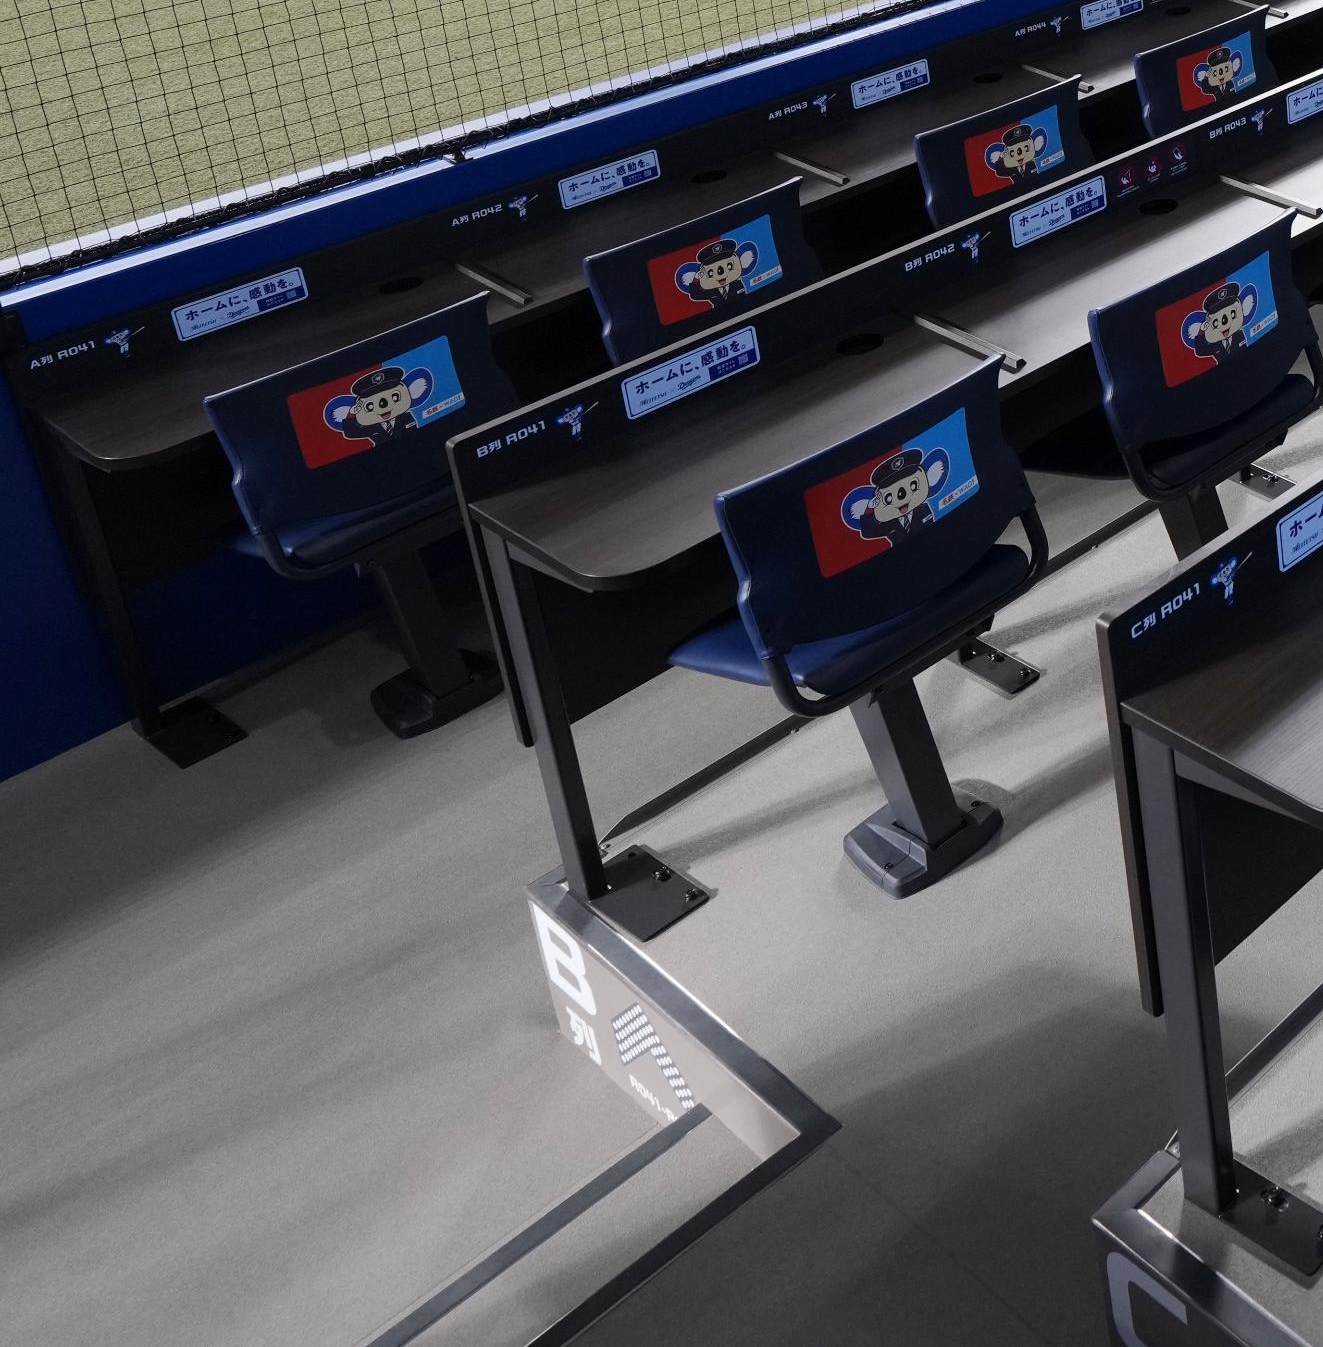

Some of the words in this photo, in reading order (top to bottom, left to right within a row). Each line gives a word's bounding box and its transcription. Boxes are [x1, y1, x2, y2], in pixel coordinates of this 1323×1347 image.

[1027, 21, 1046, 33] R044
[858, 67, 923, 94] ホームに、感動を。
[768, 111, 782, 120] A列
[784, 101, 808, 115] R043
[1224, 117, 1247, 133] R043
[568, 158, 651, 192] ホームに、感動を。
[451, 215, 470, 227] A列
[472, 204, 503, 220] R042
[1019, 186, 1098, 228] ホームに、感動を。
[904, 258, 922, 272] B列
[926, 244, 956, 263] R042
[185, 278, 294, 321] ホームに、感動を。
[30, 353, 54, 370] A列
[57, 340, 96, 361] R041
[635, 339, 747, 395] ホームに、感動を。
[476, 438, 502, 458] B列
[506, 420, 546, 446] R041
[1131, 612, 1156, 639] C列
[1160, 582, 1200, 619] R041
